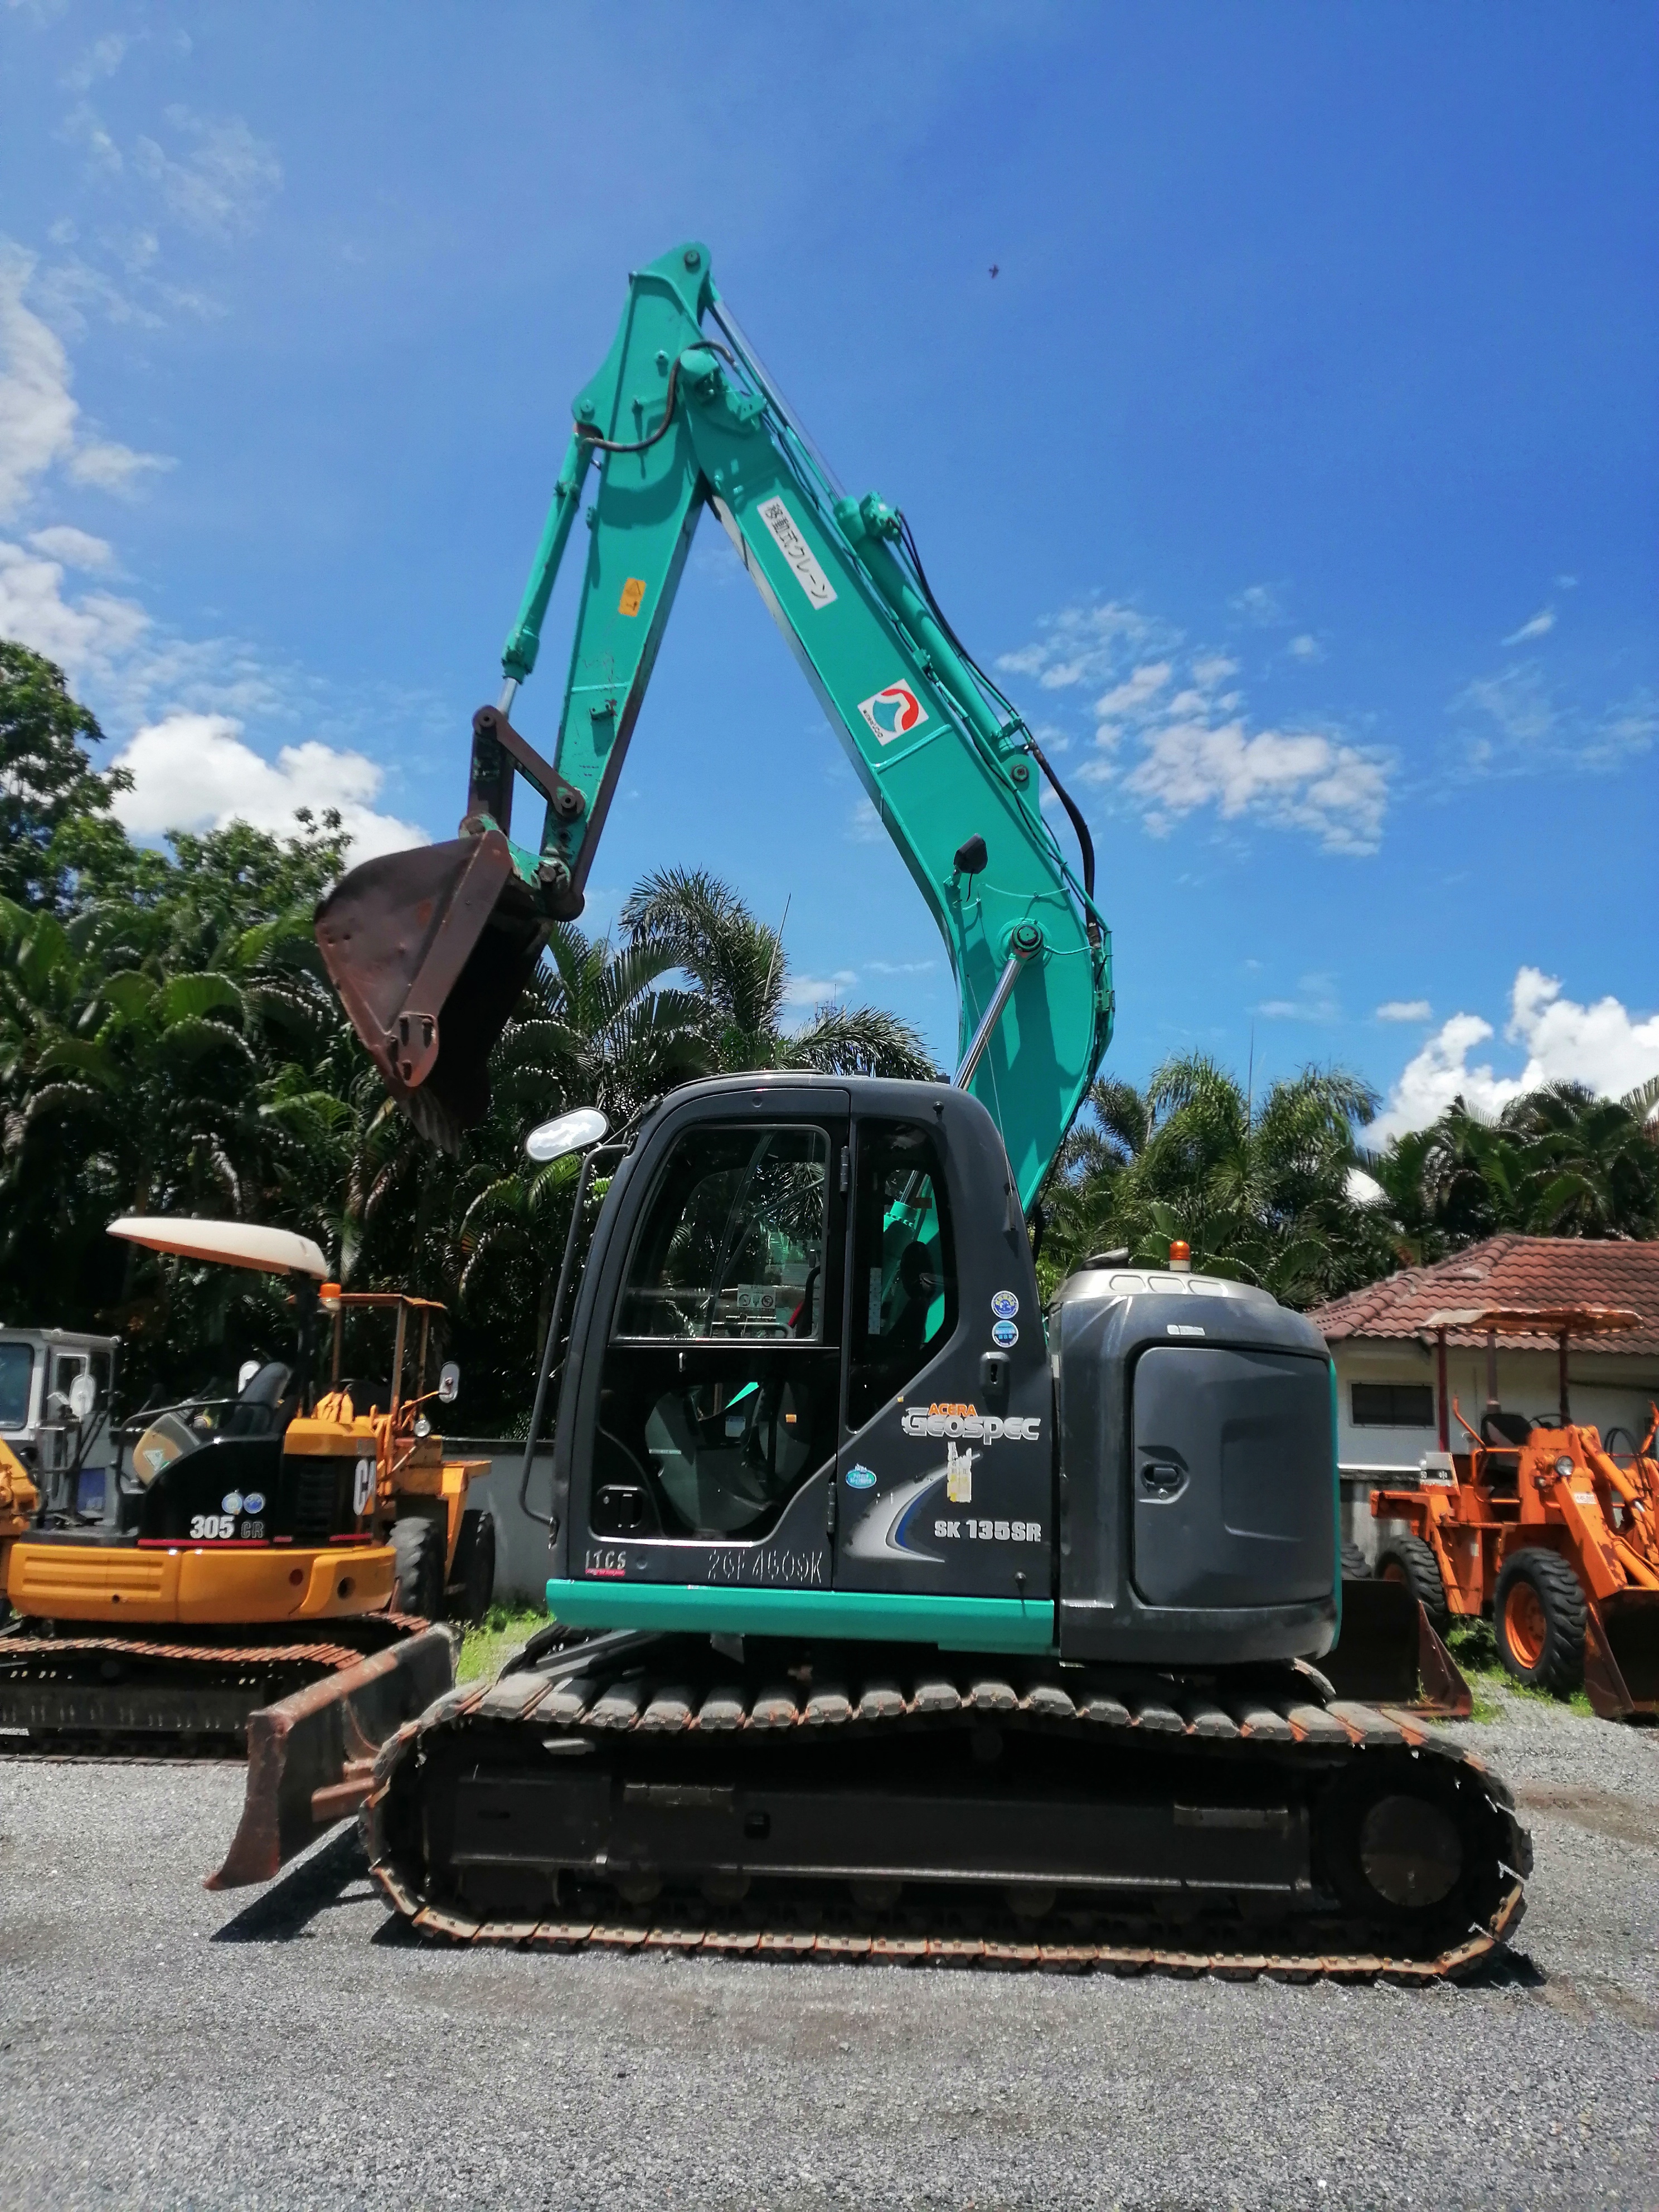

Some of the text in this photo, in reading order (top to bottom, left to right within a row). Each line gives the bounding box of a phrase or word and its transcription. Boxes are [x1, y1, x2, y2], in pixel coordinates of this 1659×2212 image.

[928, 1403, 978, 1417] ACERA
[190, 1515, 264, 1539] 305 CR
[934, 1519, 1041, 1542] SK 135SR
